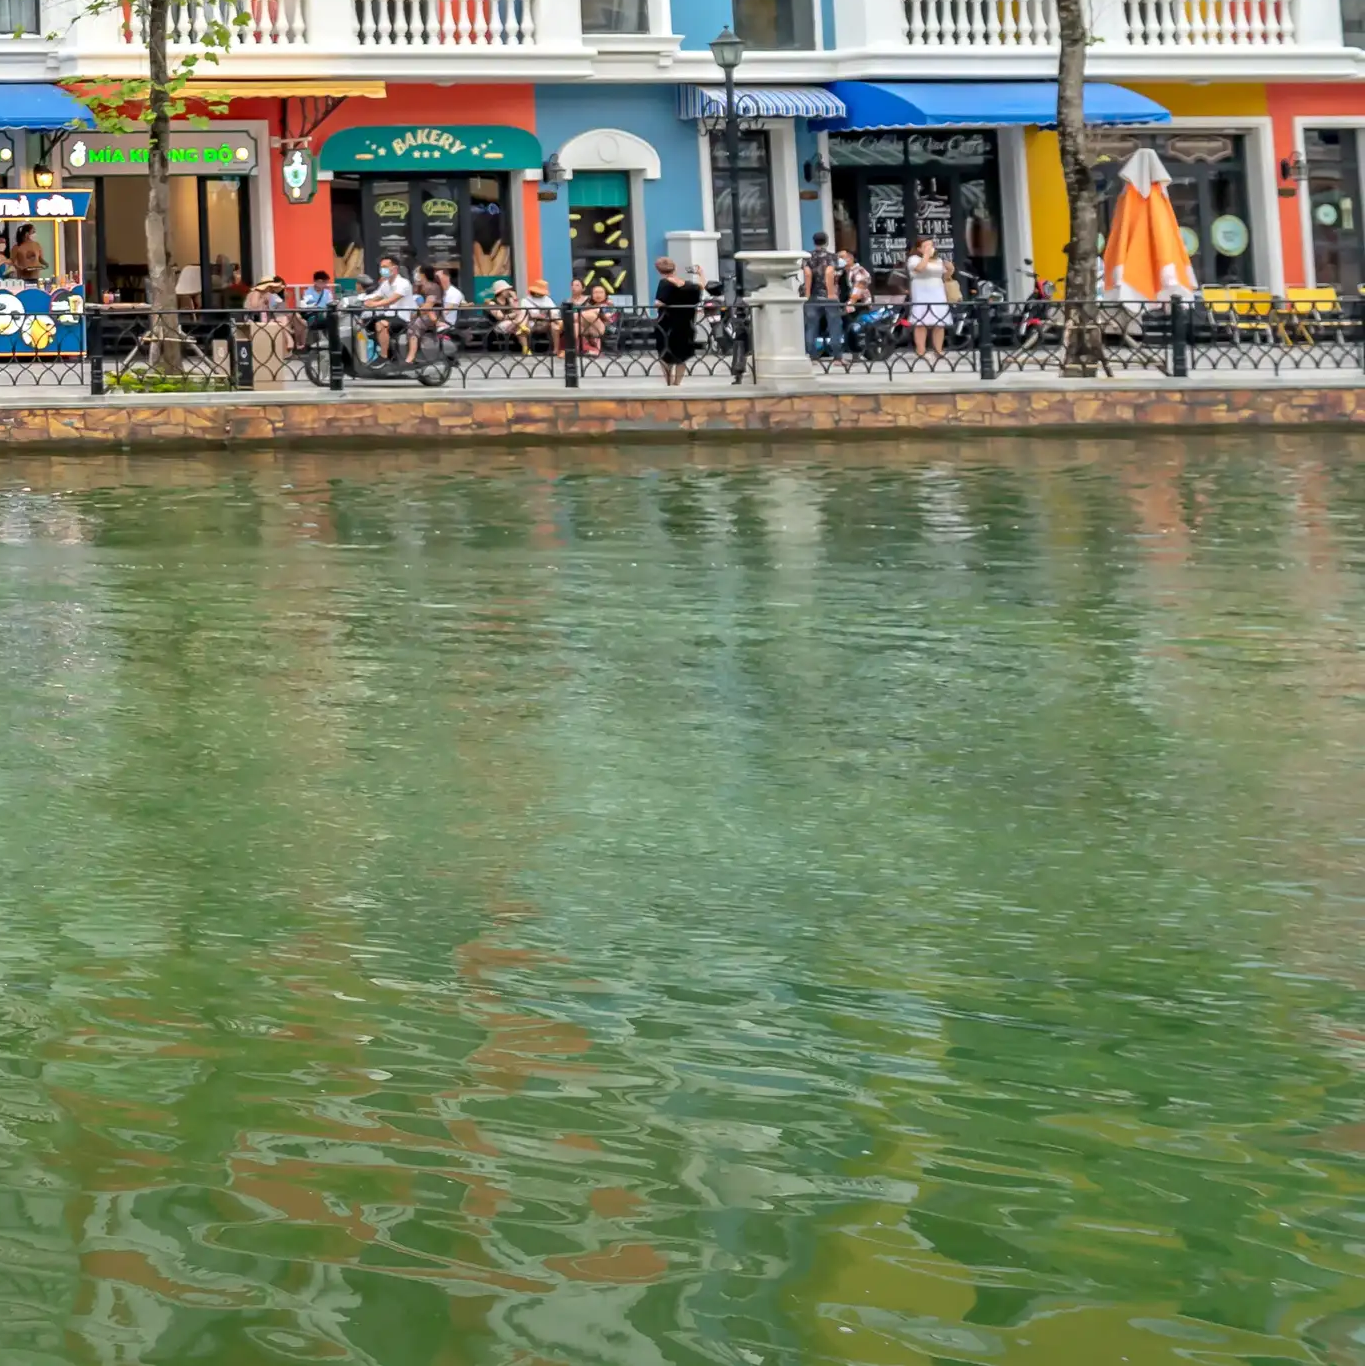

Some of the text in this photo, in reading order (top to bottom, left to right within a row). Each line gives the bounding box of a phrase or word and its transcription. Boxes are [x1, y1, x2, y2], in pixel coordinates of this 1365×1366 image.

[87, 145, 125, 163] MÍA
[203, 143, 233, 167] ĐỘ
[391, 128, 467, 157] BAKERY
